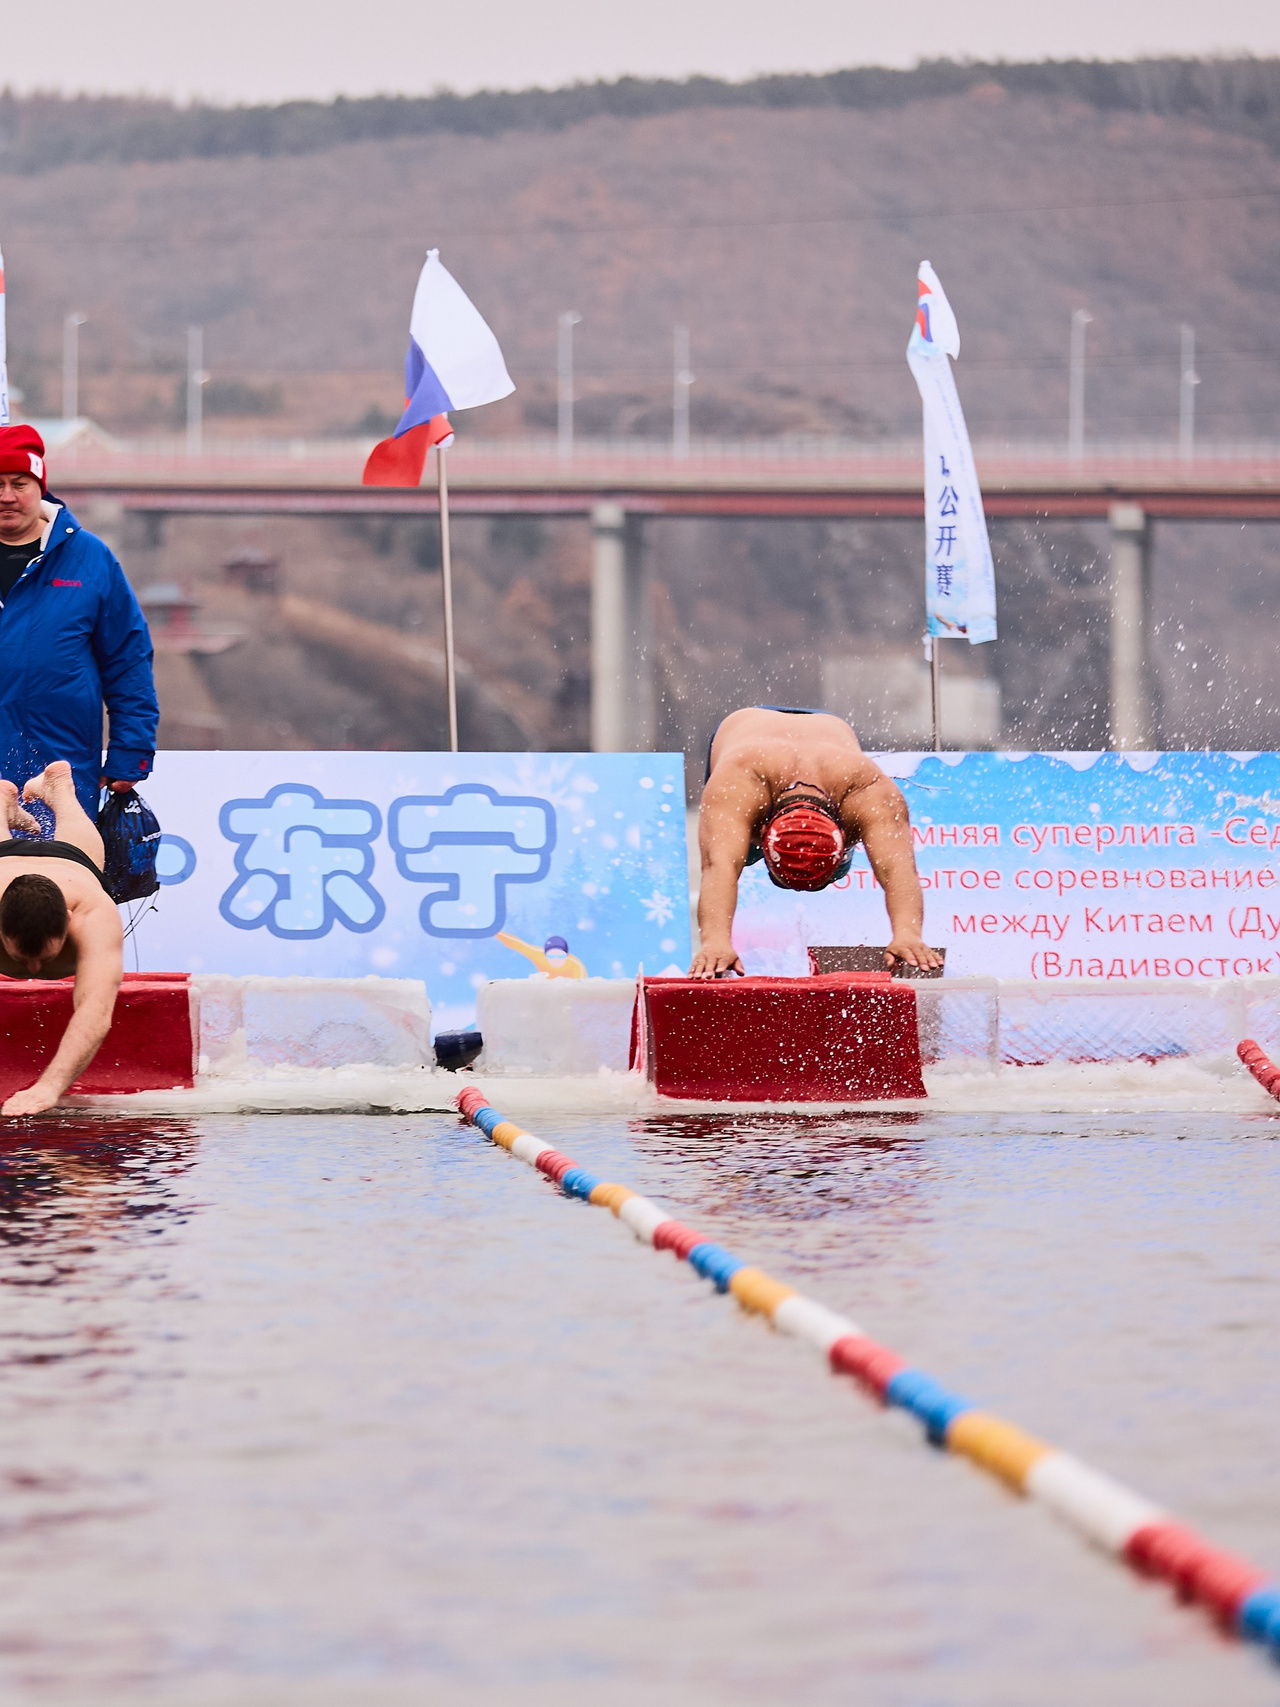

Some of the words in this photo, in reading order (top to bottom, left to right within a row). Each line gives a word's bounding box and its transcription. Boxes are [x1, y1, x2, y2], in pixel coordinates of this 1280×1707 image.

[1013, 825, 1195, 853] суперлига
[832, 869, 1001, 890] отытое
[1015, 869, 1276, 897] соревнование
[952, 914, 1070, 941] между
[1084, 907, 1213, 933] Китаем
